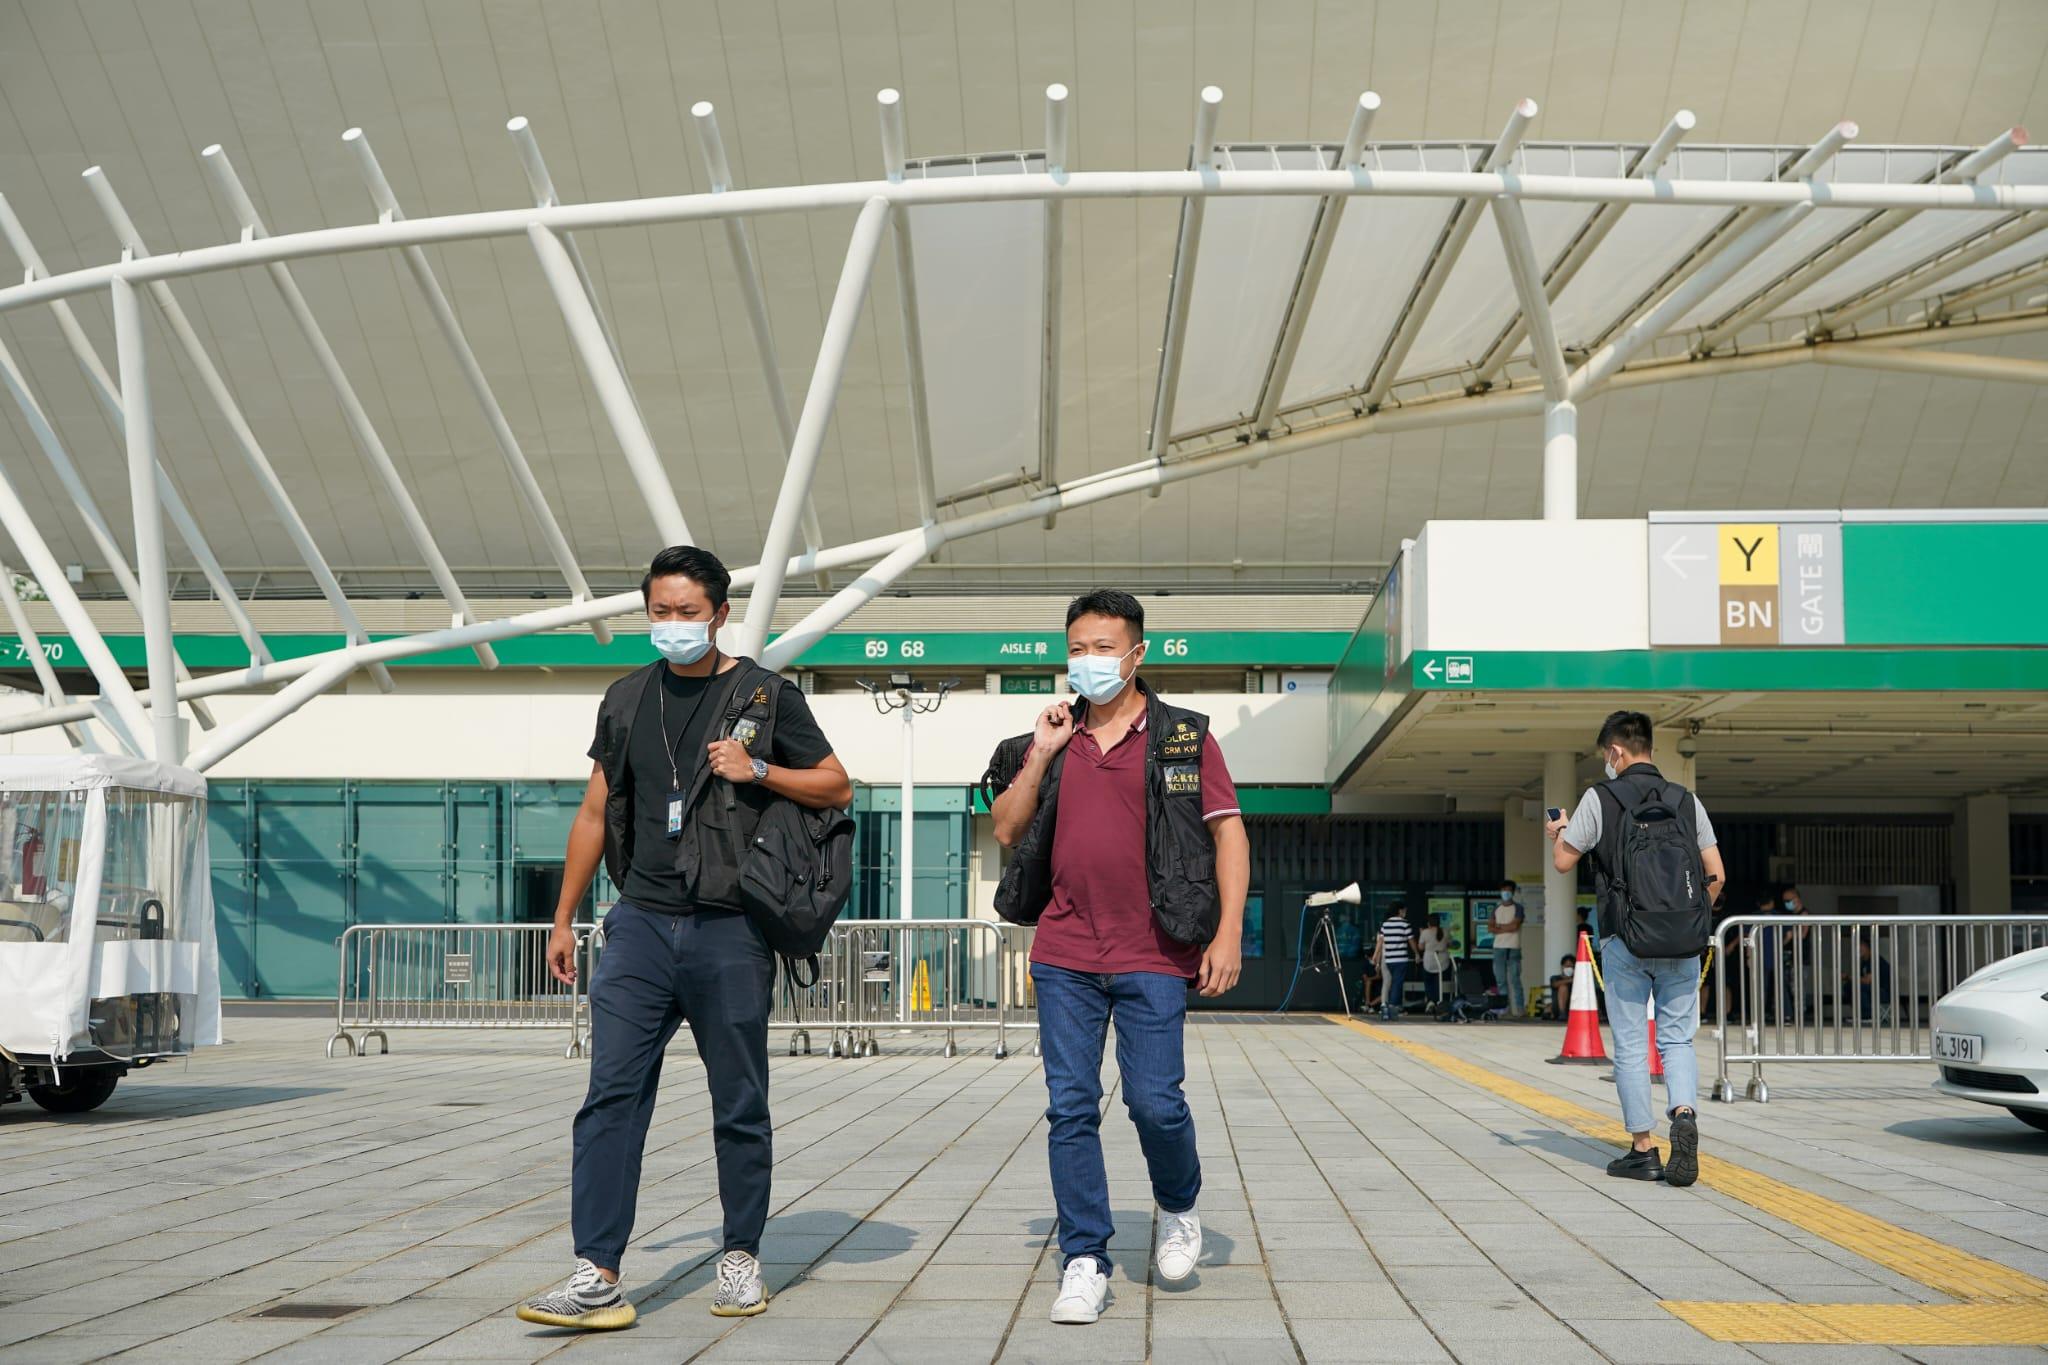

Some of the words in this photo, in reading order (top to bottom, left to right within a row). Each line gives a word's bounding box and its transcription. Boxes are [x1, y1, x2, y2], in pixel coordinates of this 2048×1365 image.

[1733, 537, 1764, 571] Y
[1800, 565, 1824, 635] GATE
[1726, 600, 1772, 628] BN
[865, 640, 888, 657] 69
[901, 640, 925, 657] 68
[1000, 643, 1032, 654] AISLE
[1164, 639, 1188, 656] 66
[1164, 732, 1198, 743] OLICE
[1184, 744, 1198, 753] KW
[1936, 1035, 1947, 1057] RL
[1950, 1037, 1973, 1059] 3191
